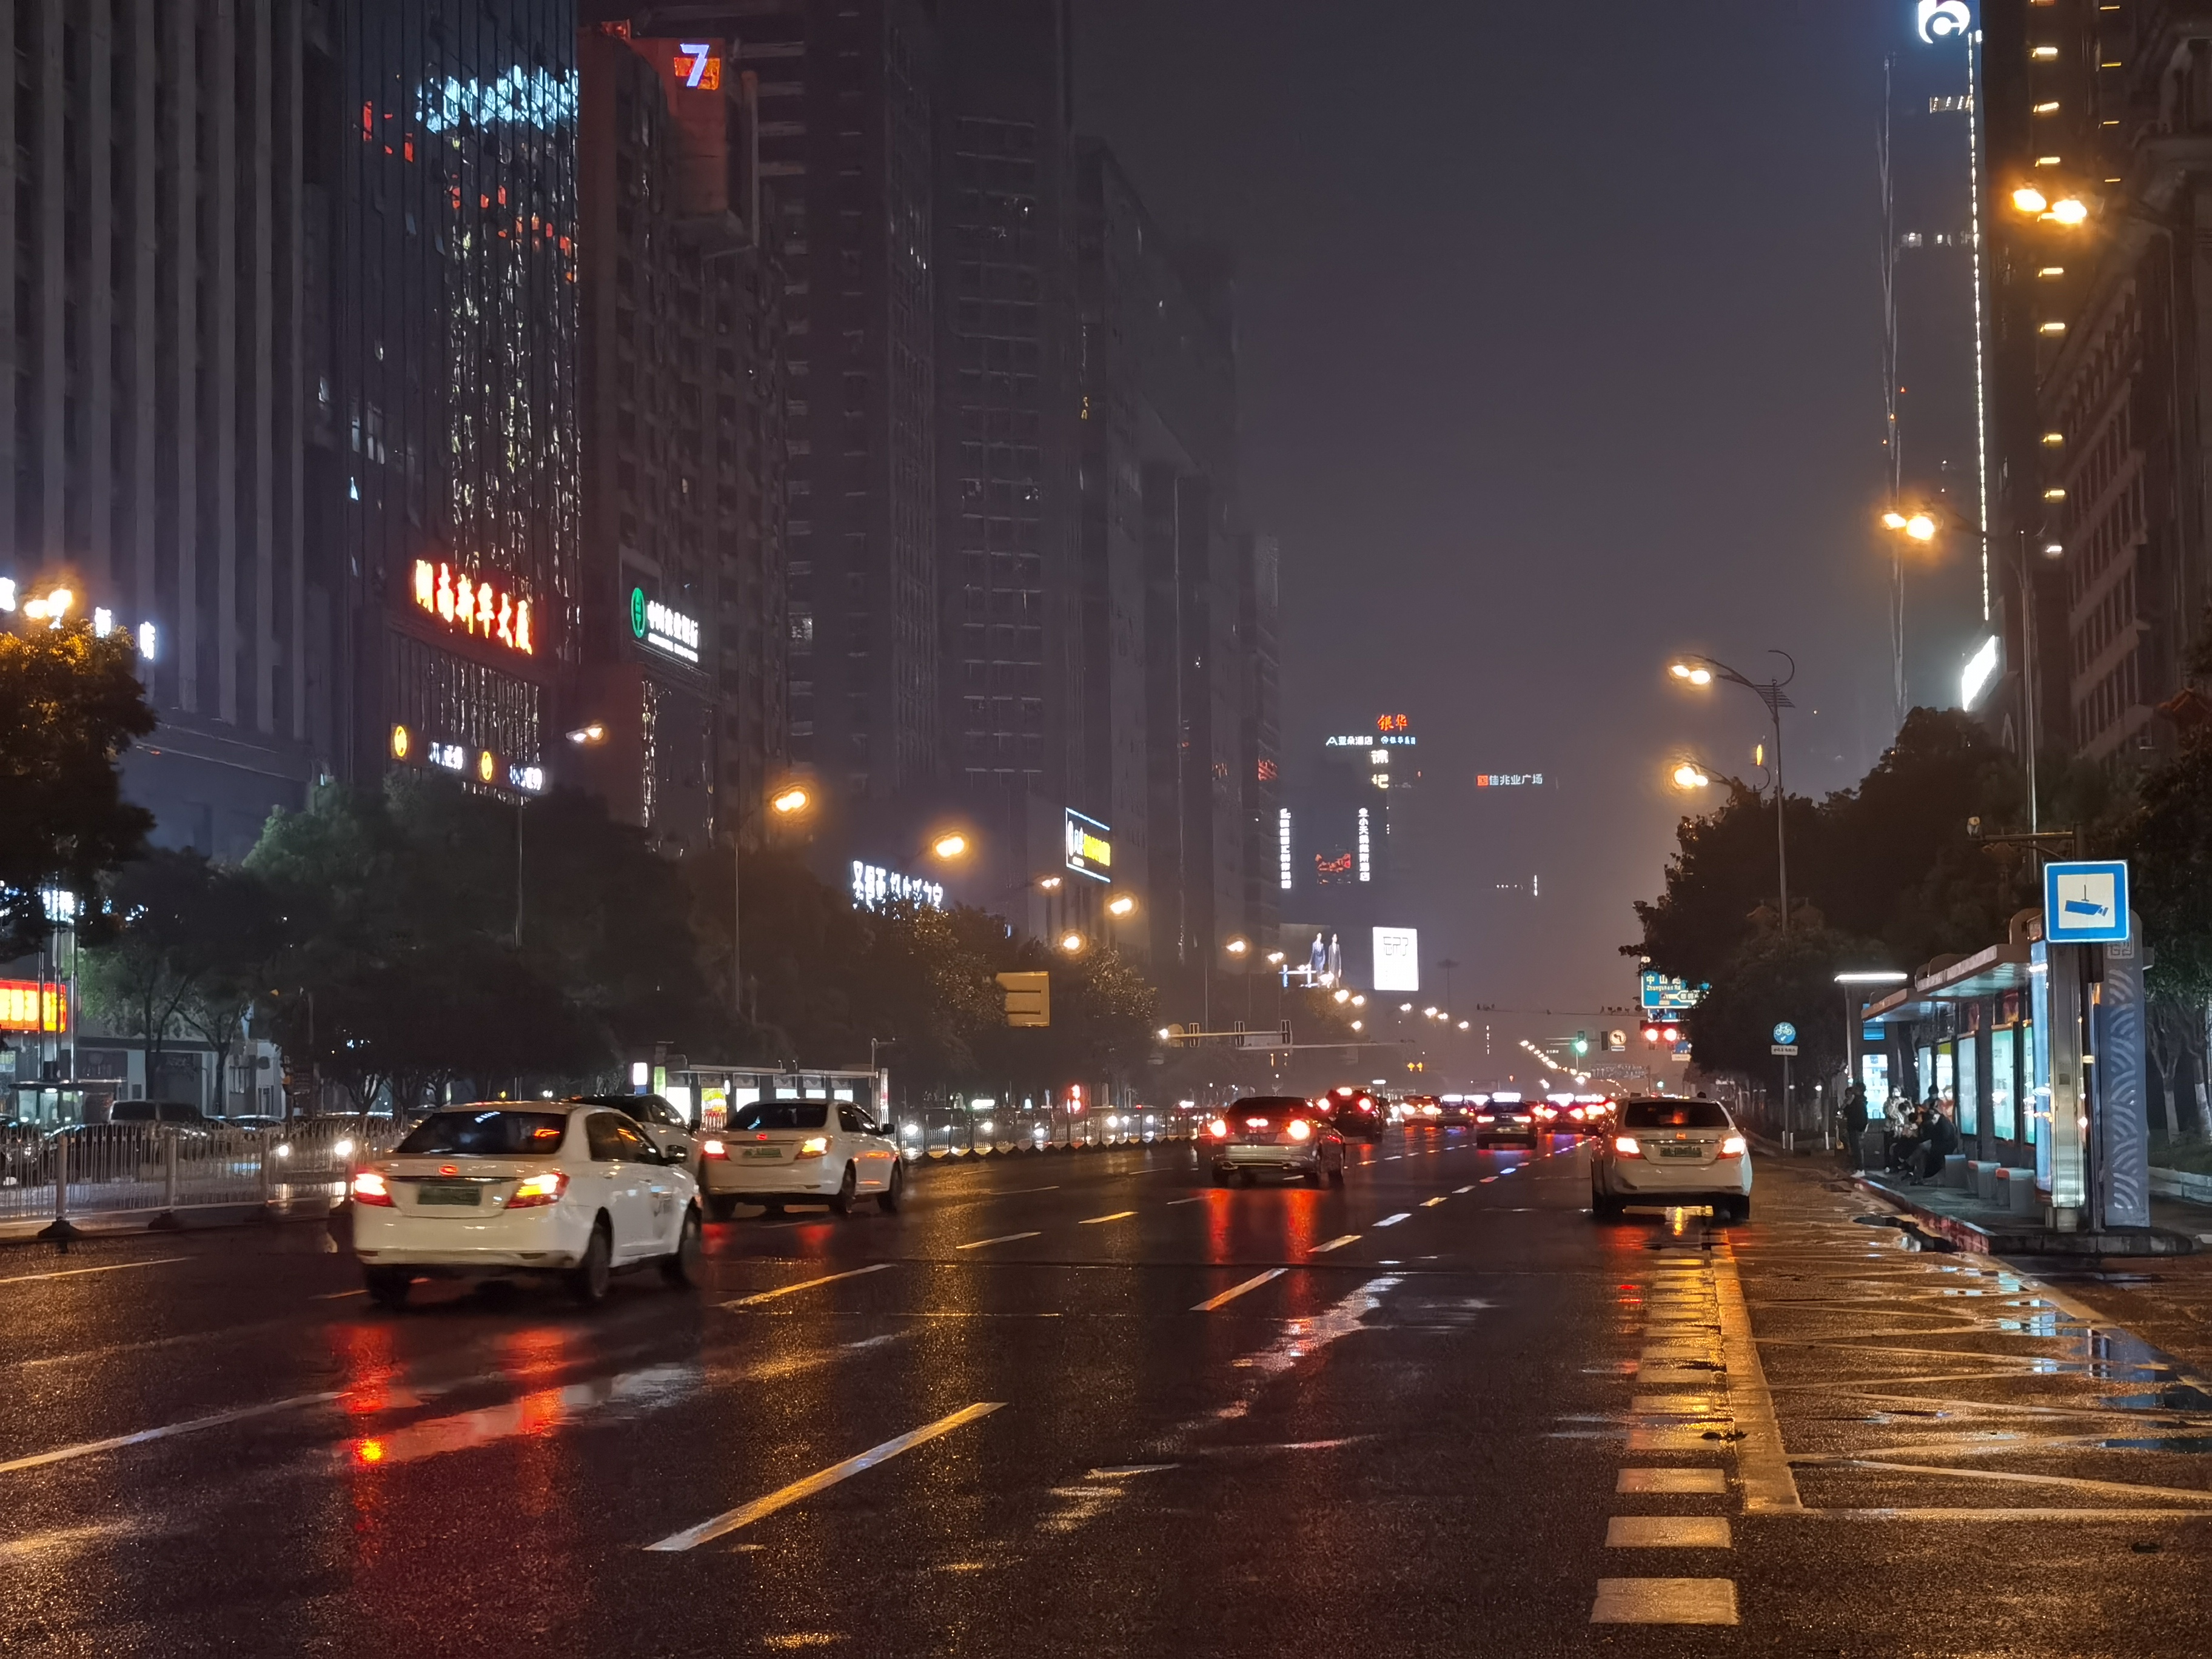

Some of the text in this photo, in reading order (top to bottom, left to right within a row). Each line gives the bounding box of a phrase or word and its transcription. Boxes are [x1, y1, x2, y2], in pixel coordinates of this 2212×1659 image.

[1377, 714, 1407, 731] 银华
[1489, 774, 1543, 785] 佳兆业广场
